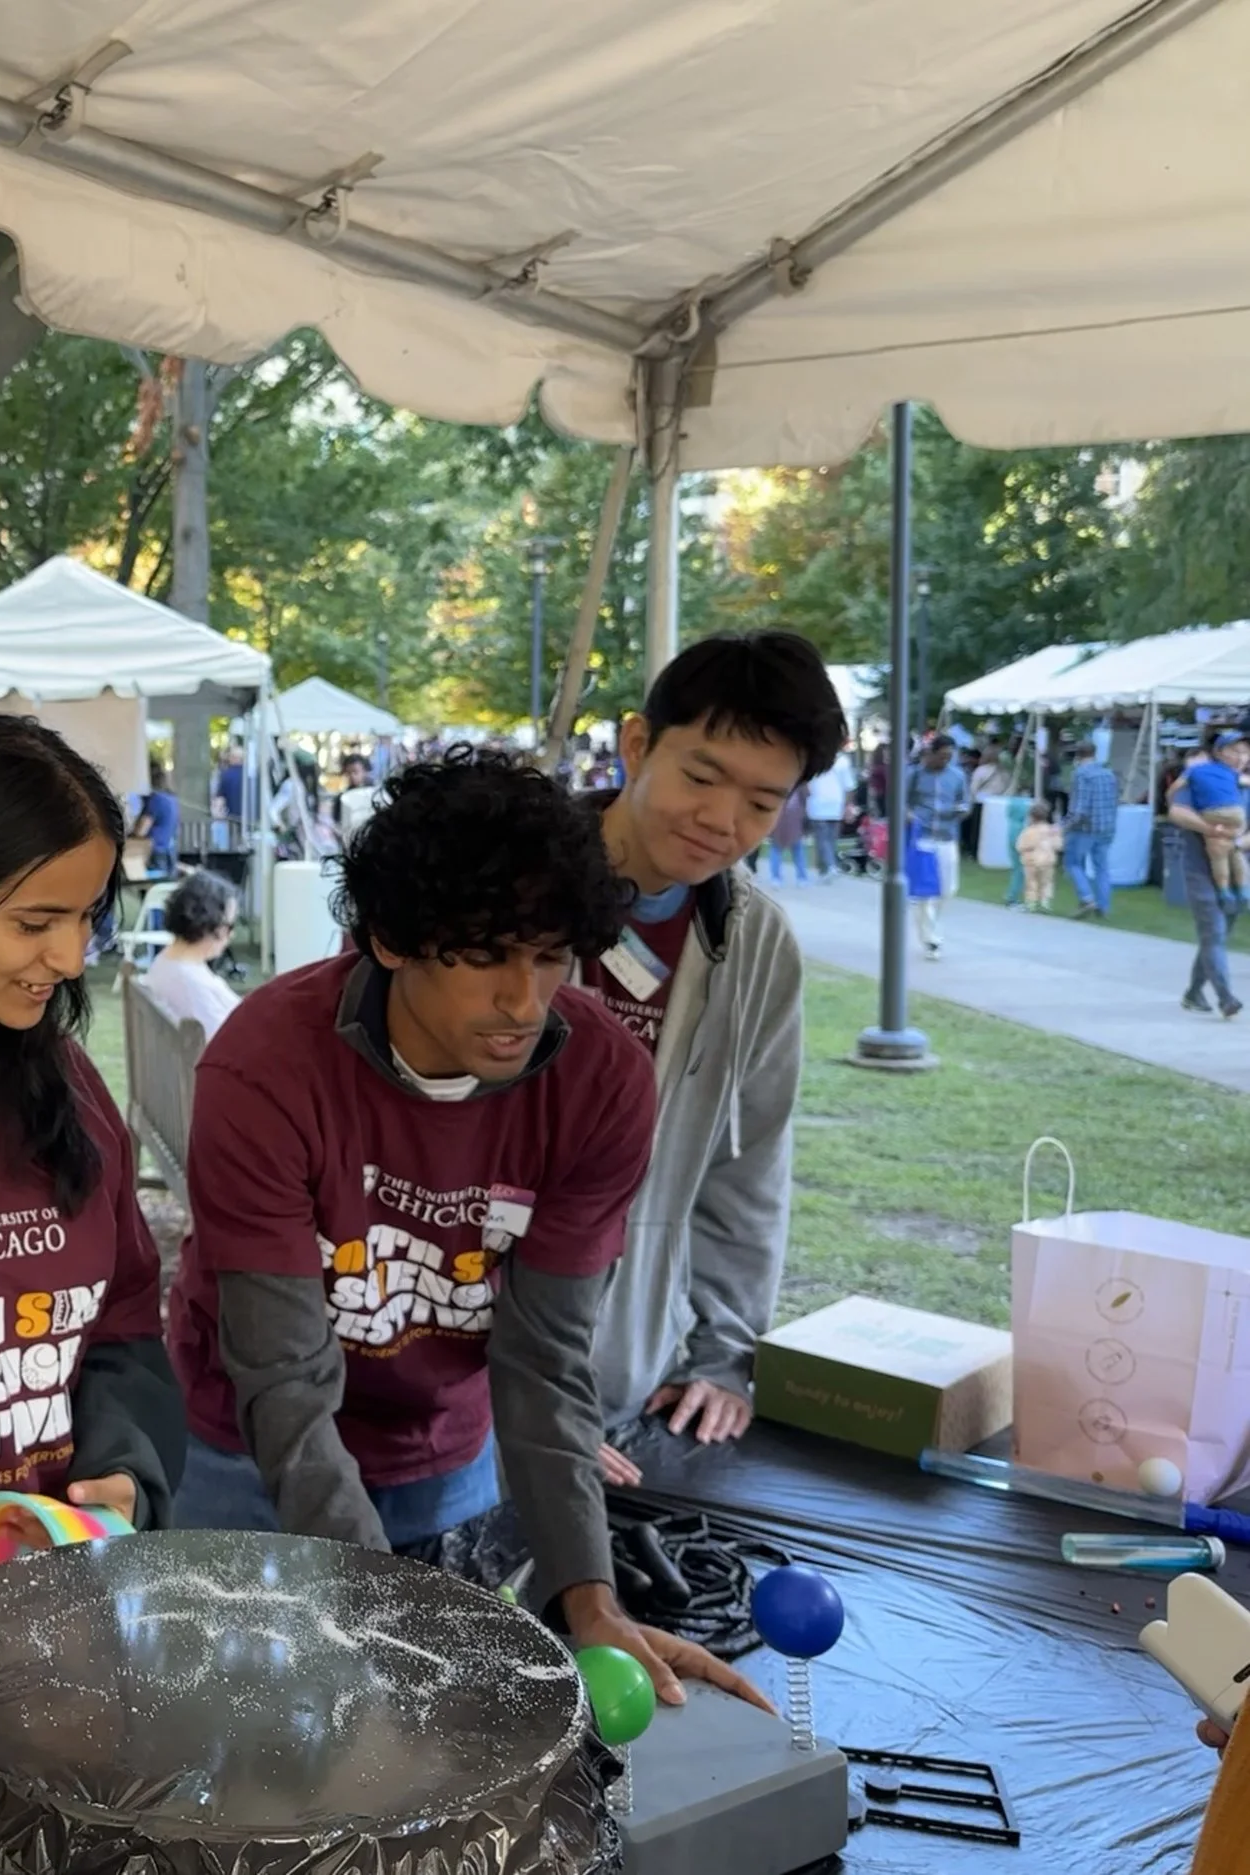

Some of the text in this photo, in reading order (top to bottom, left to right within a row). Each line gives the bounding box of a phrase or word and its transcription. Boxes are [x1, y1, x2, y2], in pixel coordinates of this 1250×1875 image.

[606, 996, 664, 1019] UNIVERSI
[382, 1172, 413, 1192] THE
[41, 1206, 59, 1220] OF
[377, 1185, 488, 1228] CHICAG
[329, 1260, 494, 1313] SCIENC
[833, 1392, 849, 1408] to
